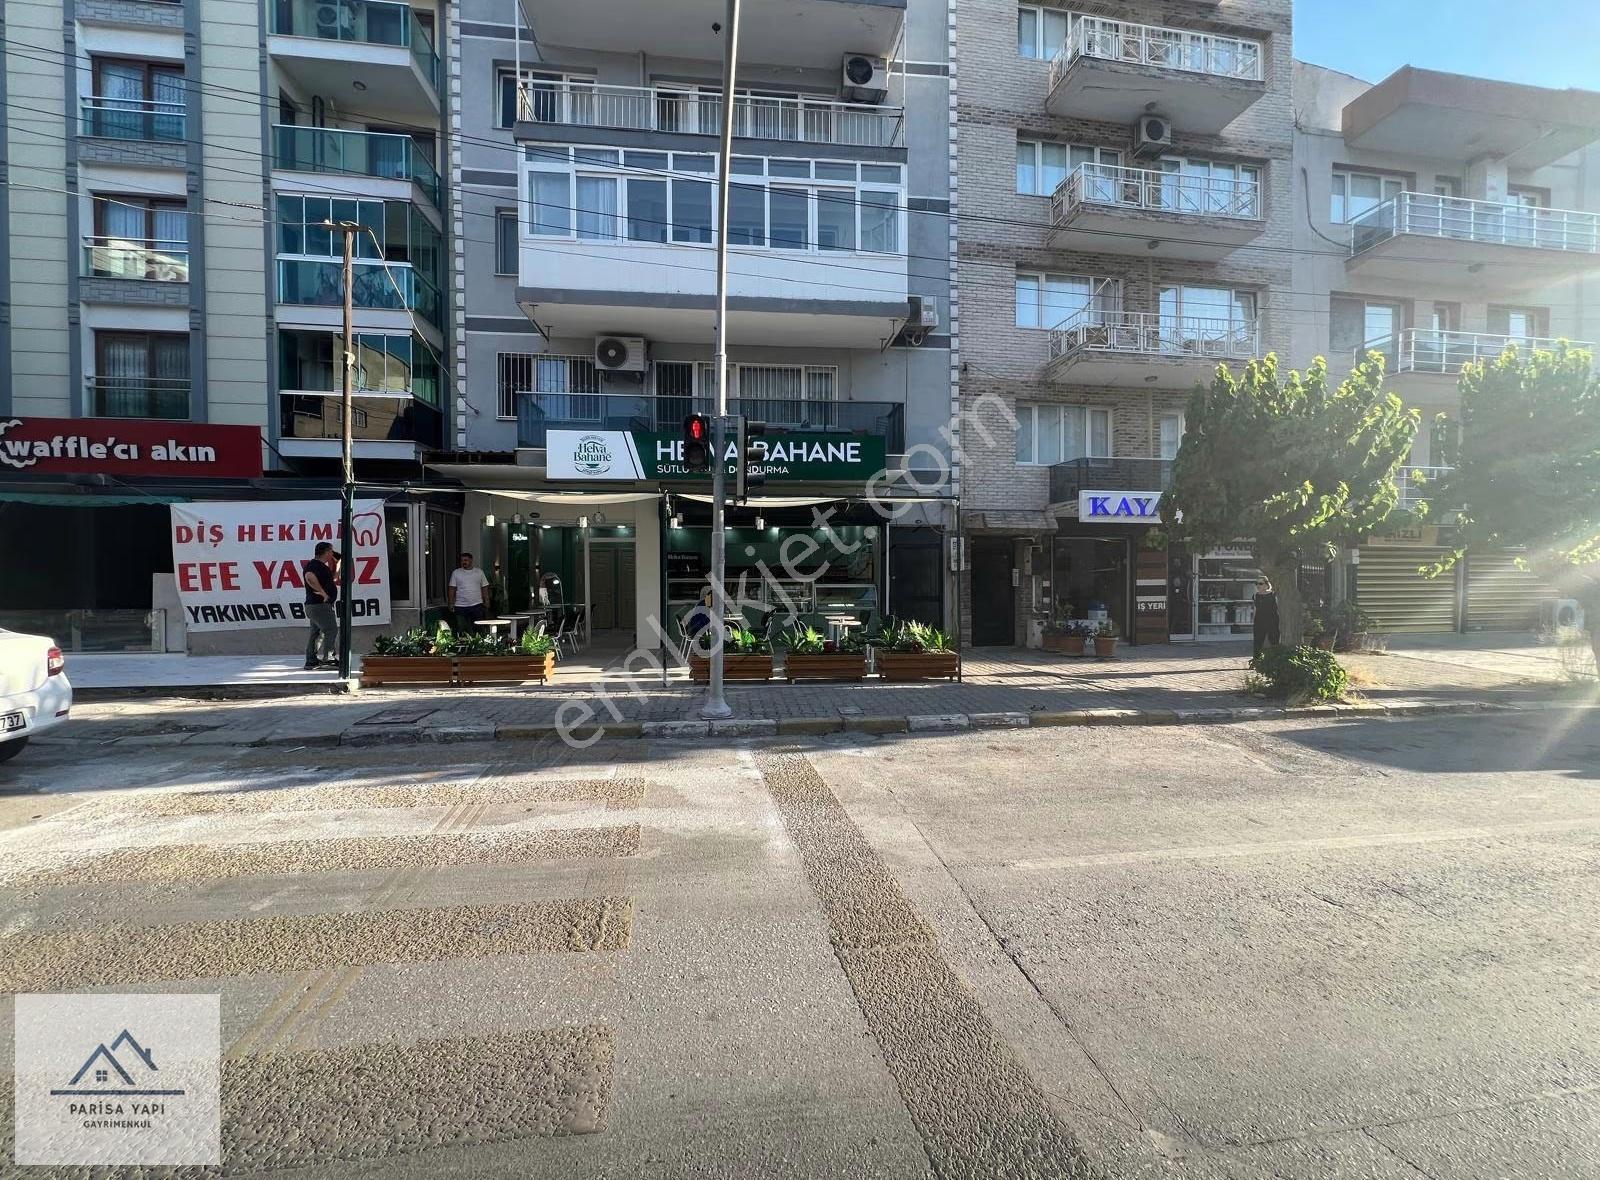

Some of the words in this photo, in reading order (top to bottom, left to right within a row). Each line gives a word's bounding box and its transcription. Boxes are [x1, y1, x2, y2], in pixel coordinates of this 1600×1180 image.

[151, 440, 216, 462] akın
[573, 452, 611, 462] Bahane
[577, 443, 607, 453] Helva
[656, 440, 738, 461] HEA
[752, 441, 861, 463] BAHANE
[728, 464, 789, 474] DNDURMA
[175, 520, 224, 548] DİŞ
[237, 519, 343, 542] HEKİMİ
[178, 561, 241, 592] EFE
[186, 603, 286, 624] YAKINDA
[289, 598, 380, 619] BDA
